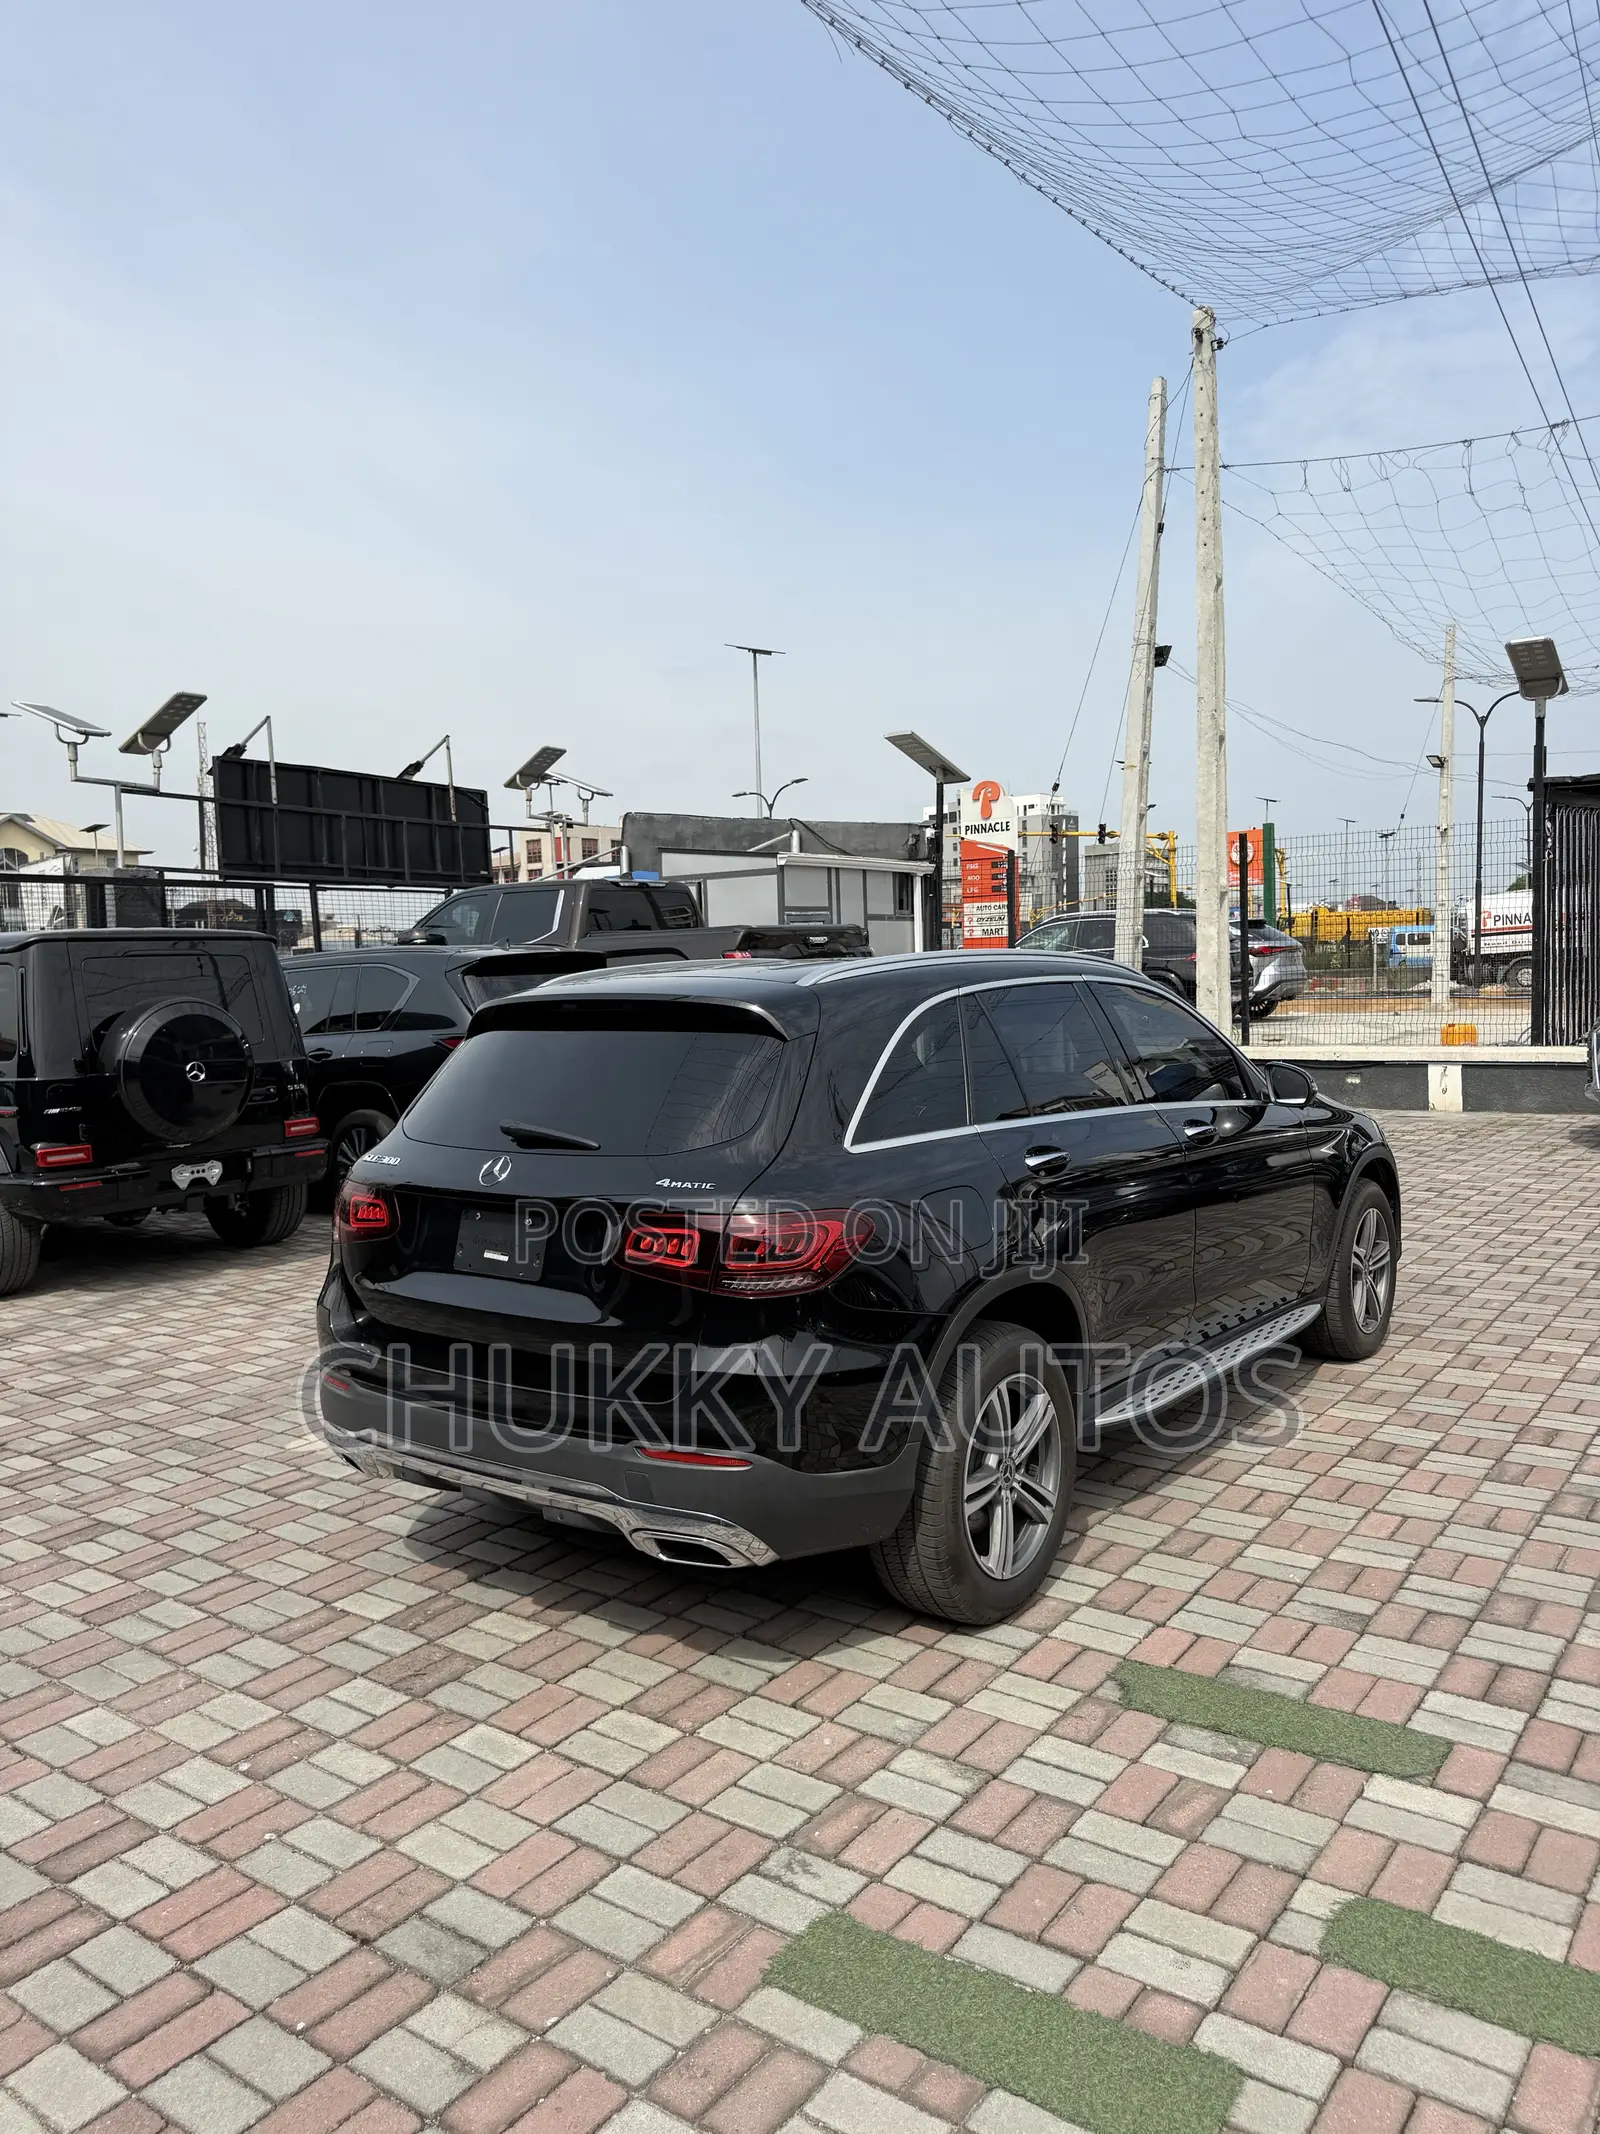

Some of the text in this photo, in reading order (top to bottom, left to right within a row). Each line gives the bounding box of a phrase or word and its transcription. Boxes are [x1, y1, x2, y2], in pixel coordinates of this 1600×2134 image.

[964, 821, 1011, 835] PINNACLE
[976, 903, 1009, 912] AUTO CAR
[1493, 912, 1532, 926] PINNA
[981, 927, 1004, 936] MART
[655, 1178, 717, 1190] 4MATIC
